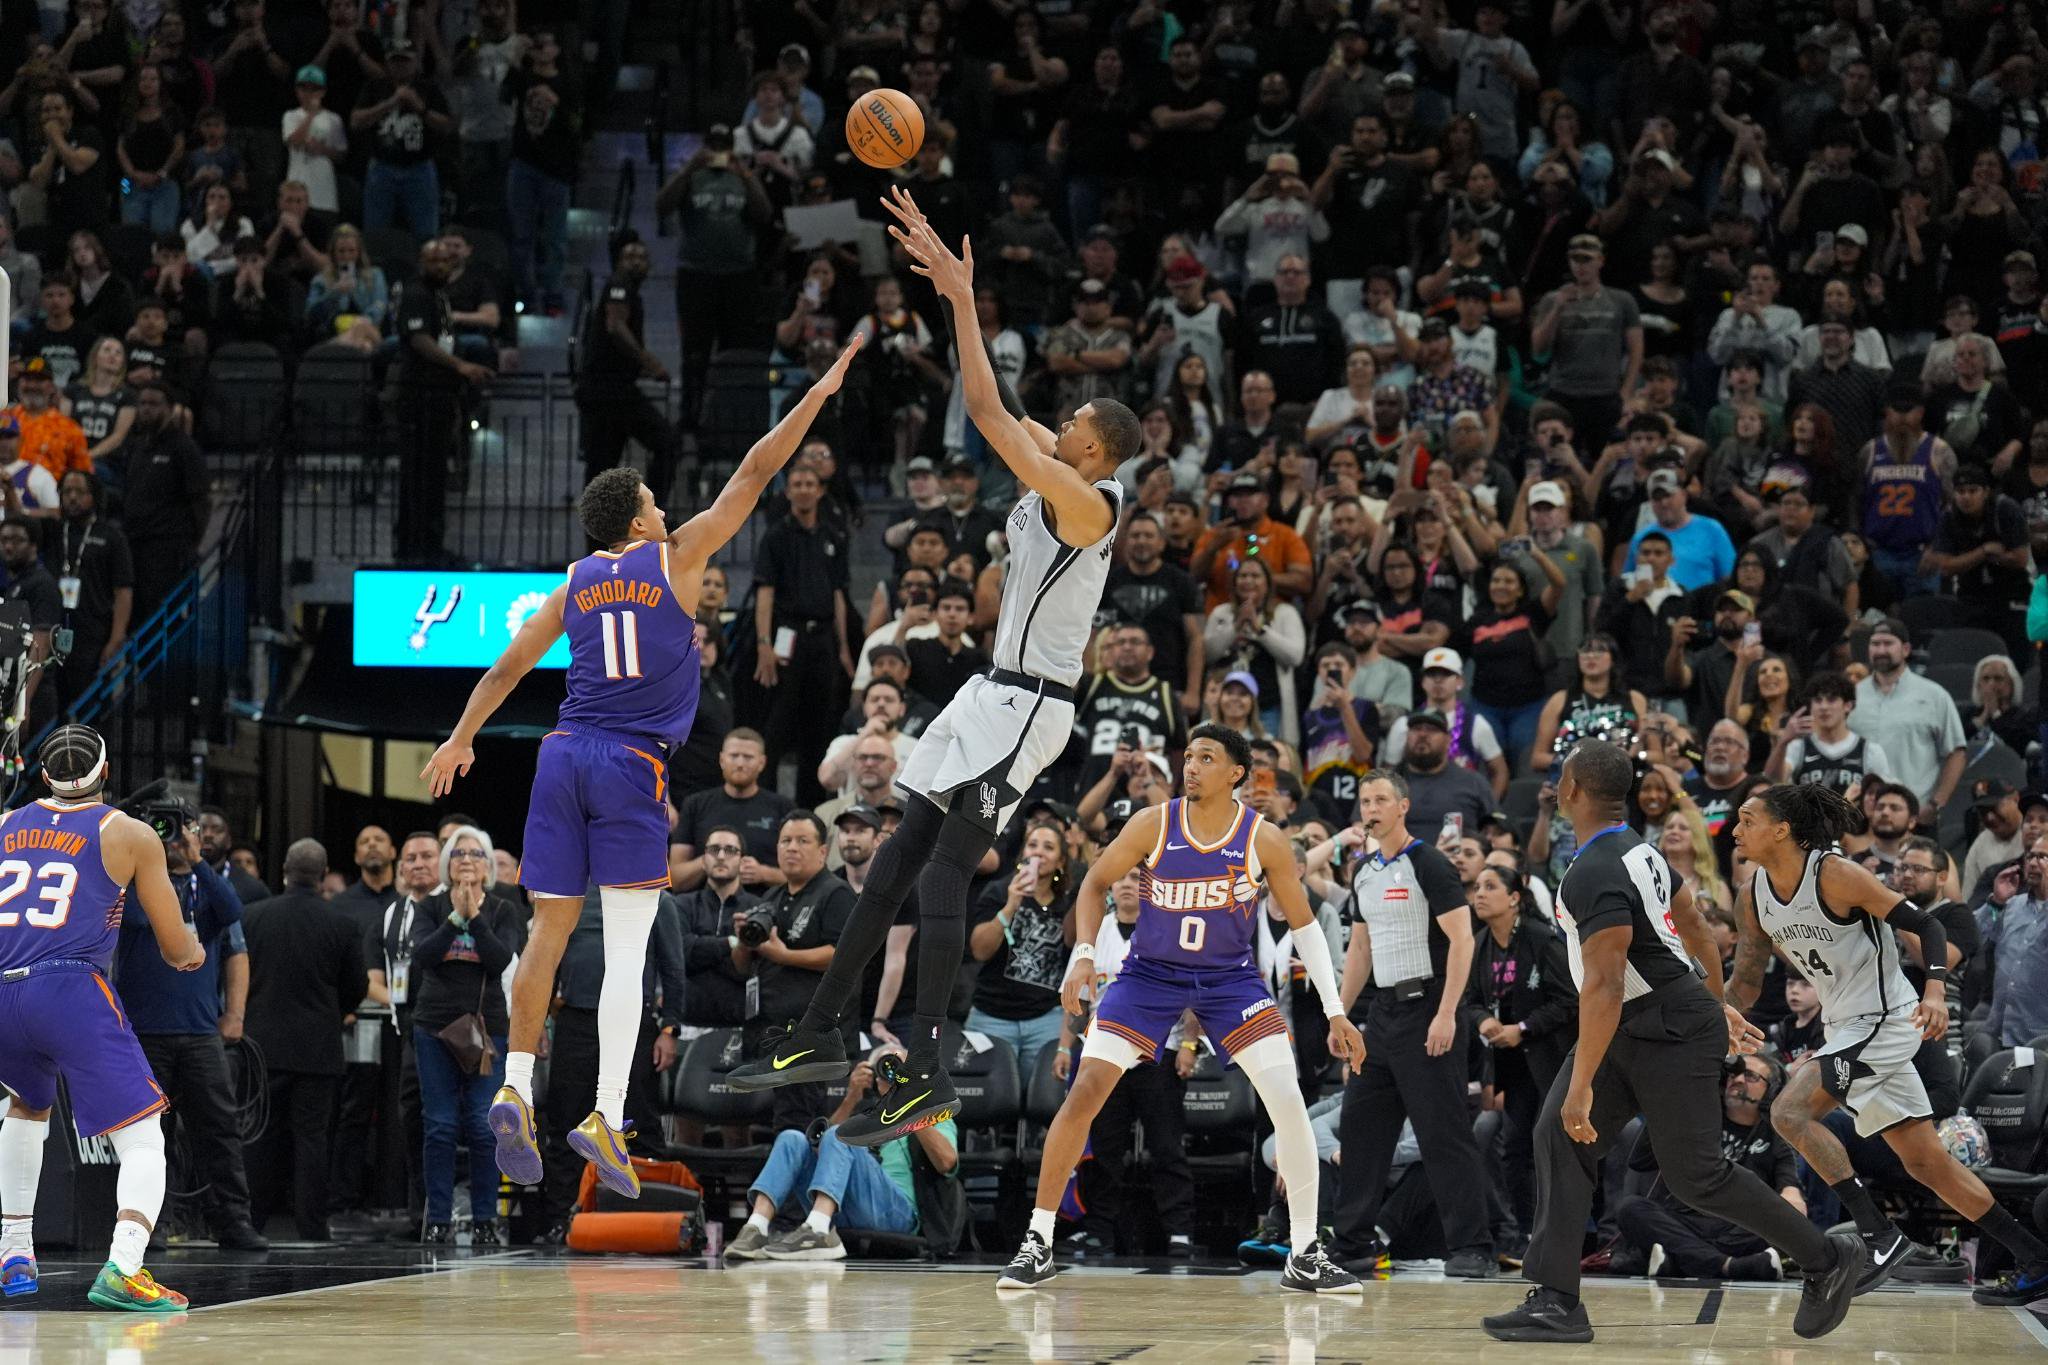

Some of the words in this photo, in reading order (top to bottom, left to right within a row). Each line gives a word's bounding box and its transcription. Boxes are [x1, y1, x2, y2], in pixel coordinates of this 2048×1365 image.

[868, 99, 905, 147] Wilson
[1878, 485, 1916, 519] 22
[574, 579, 663, 615] IGHODARO
[600, 610, 644, 680] 11
[1332, 775, 1356, 800] 12
[4, 828, 88, 857] GOODWIN
[1220, 848, 1244, 860] PayPal
[0, 859, 80, 930] 23
[1151, 878, 1230, 910] SUNS
[1178, 915, 1207, 953] 0
[1782, 923, 1834, 942] ANTONIO
